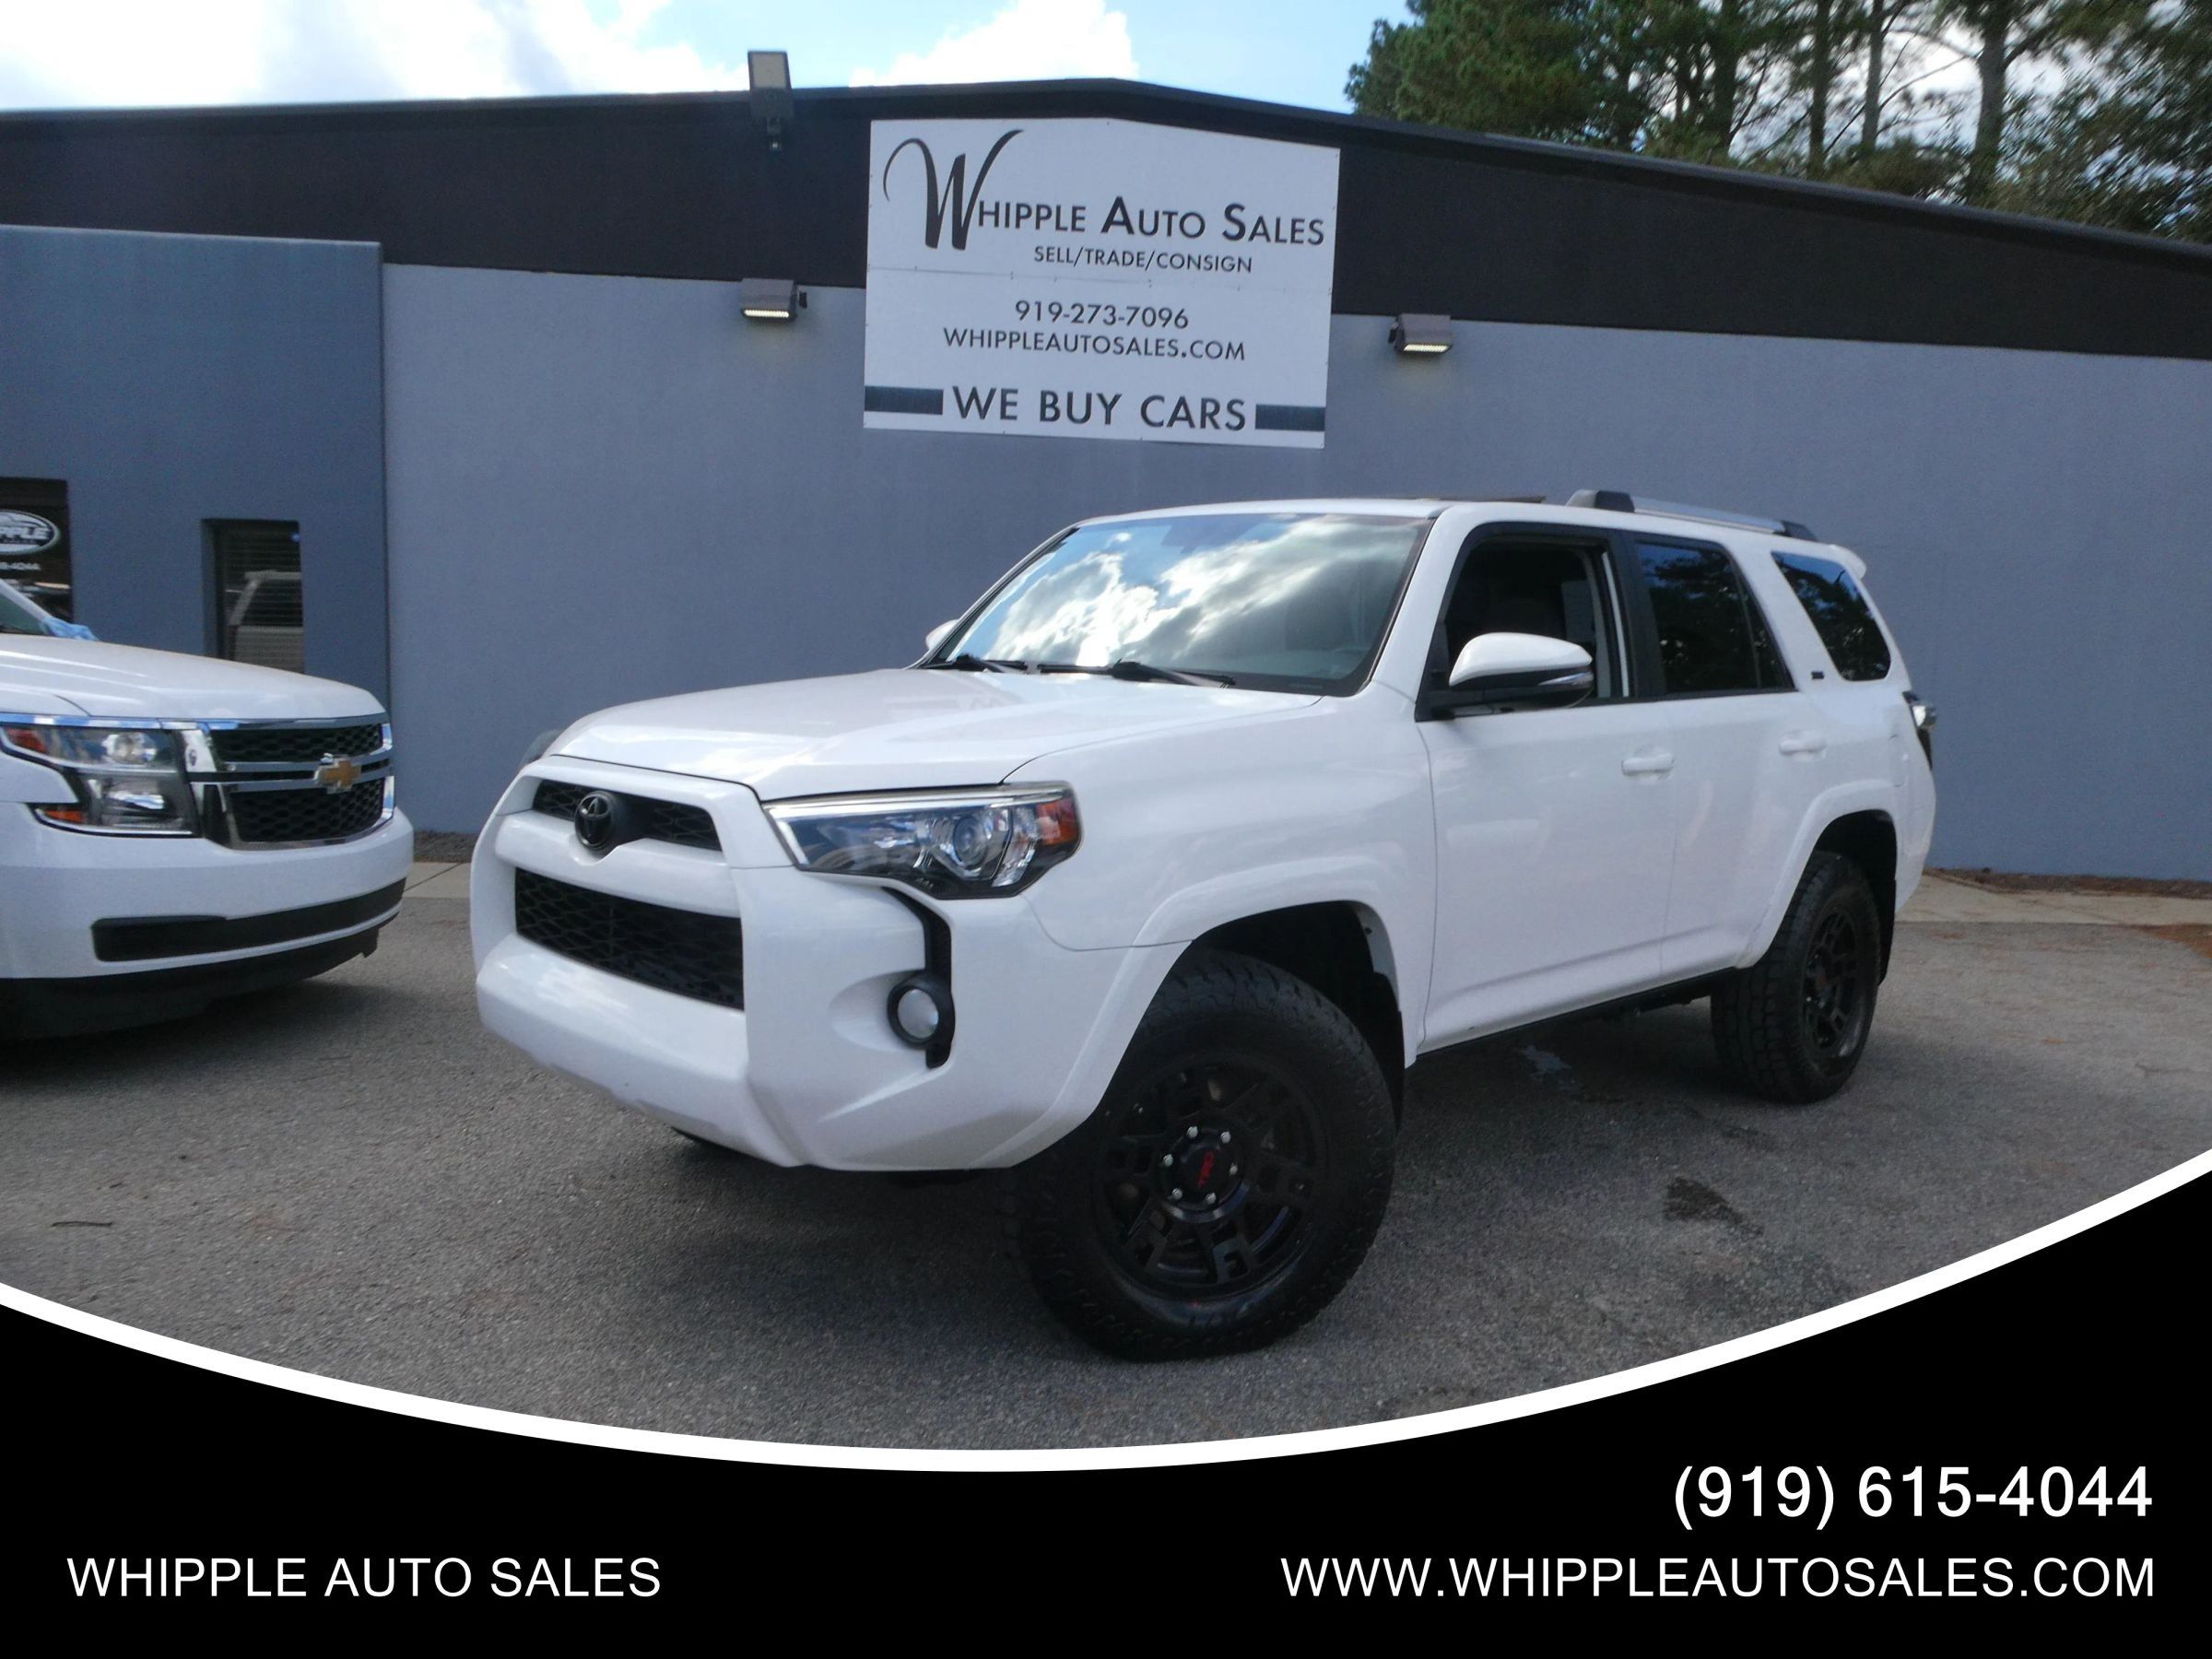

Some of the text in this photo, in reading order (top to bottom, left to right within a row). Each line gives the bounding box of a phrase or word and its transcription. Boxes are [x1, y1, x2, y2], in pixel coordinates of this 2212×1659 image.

[884, 130, 1324, 250] WHIPPLE AUTO SALES
[1033, 246, 1253, 274] SELL/TRADE/CONSIGN
[1015, 300, 1189, 330] 919-273-7096
[944, 328, 1245, 362] WHIPPLEAUTOSALES.COM
[952, 385, 1246, 431] WE BUY CARS
